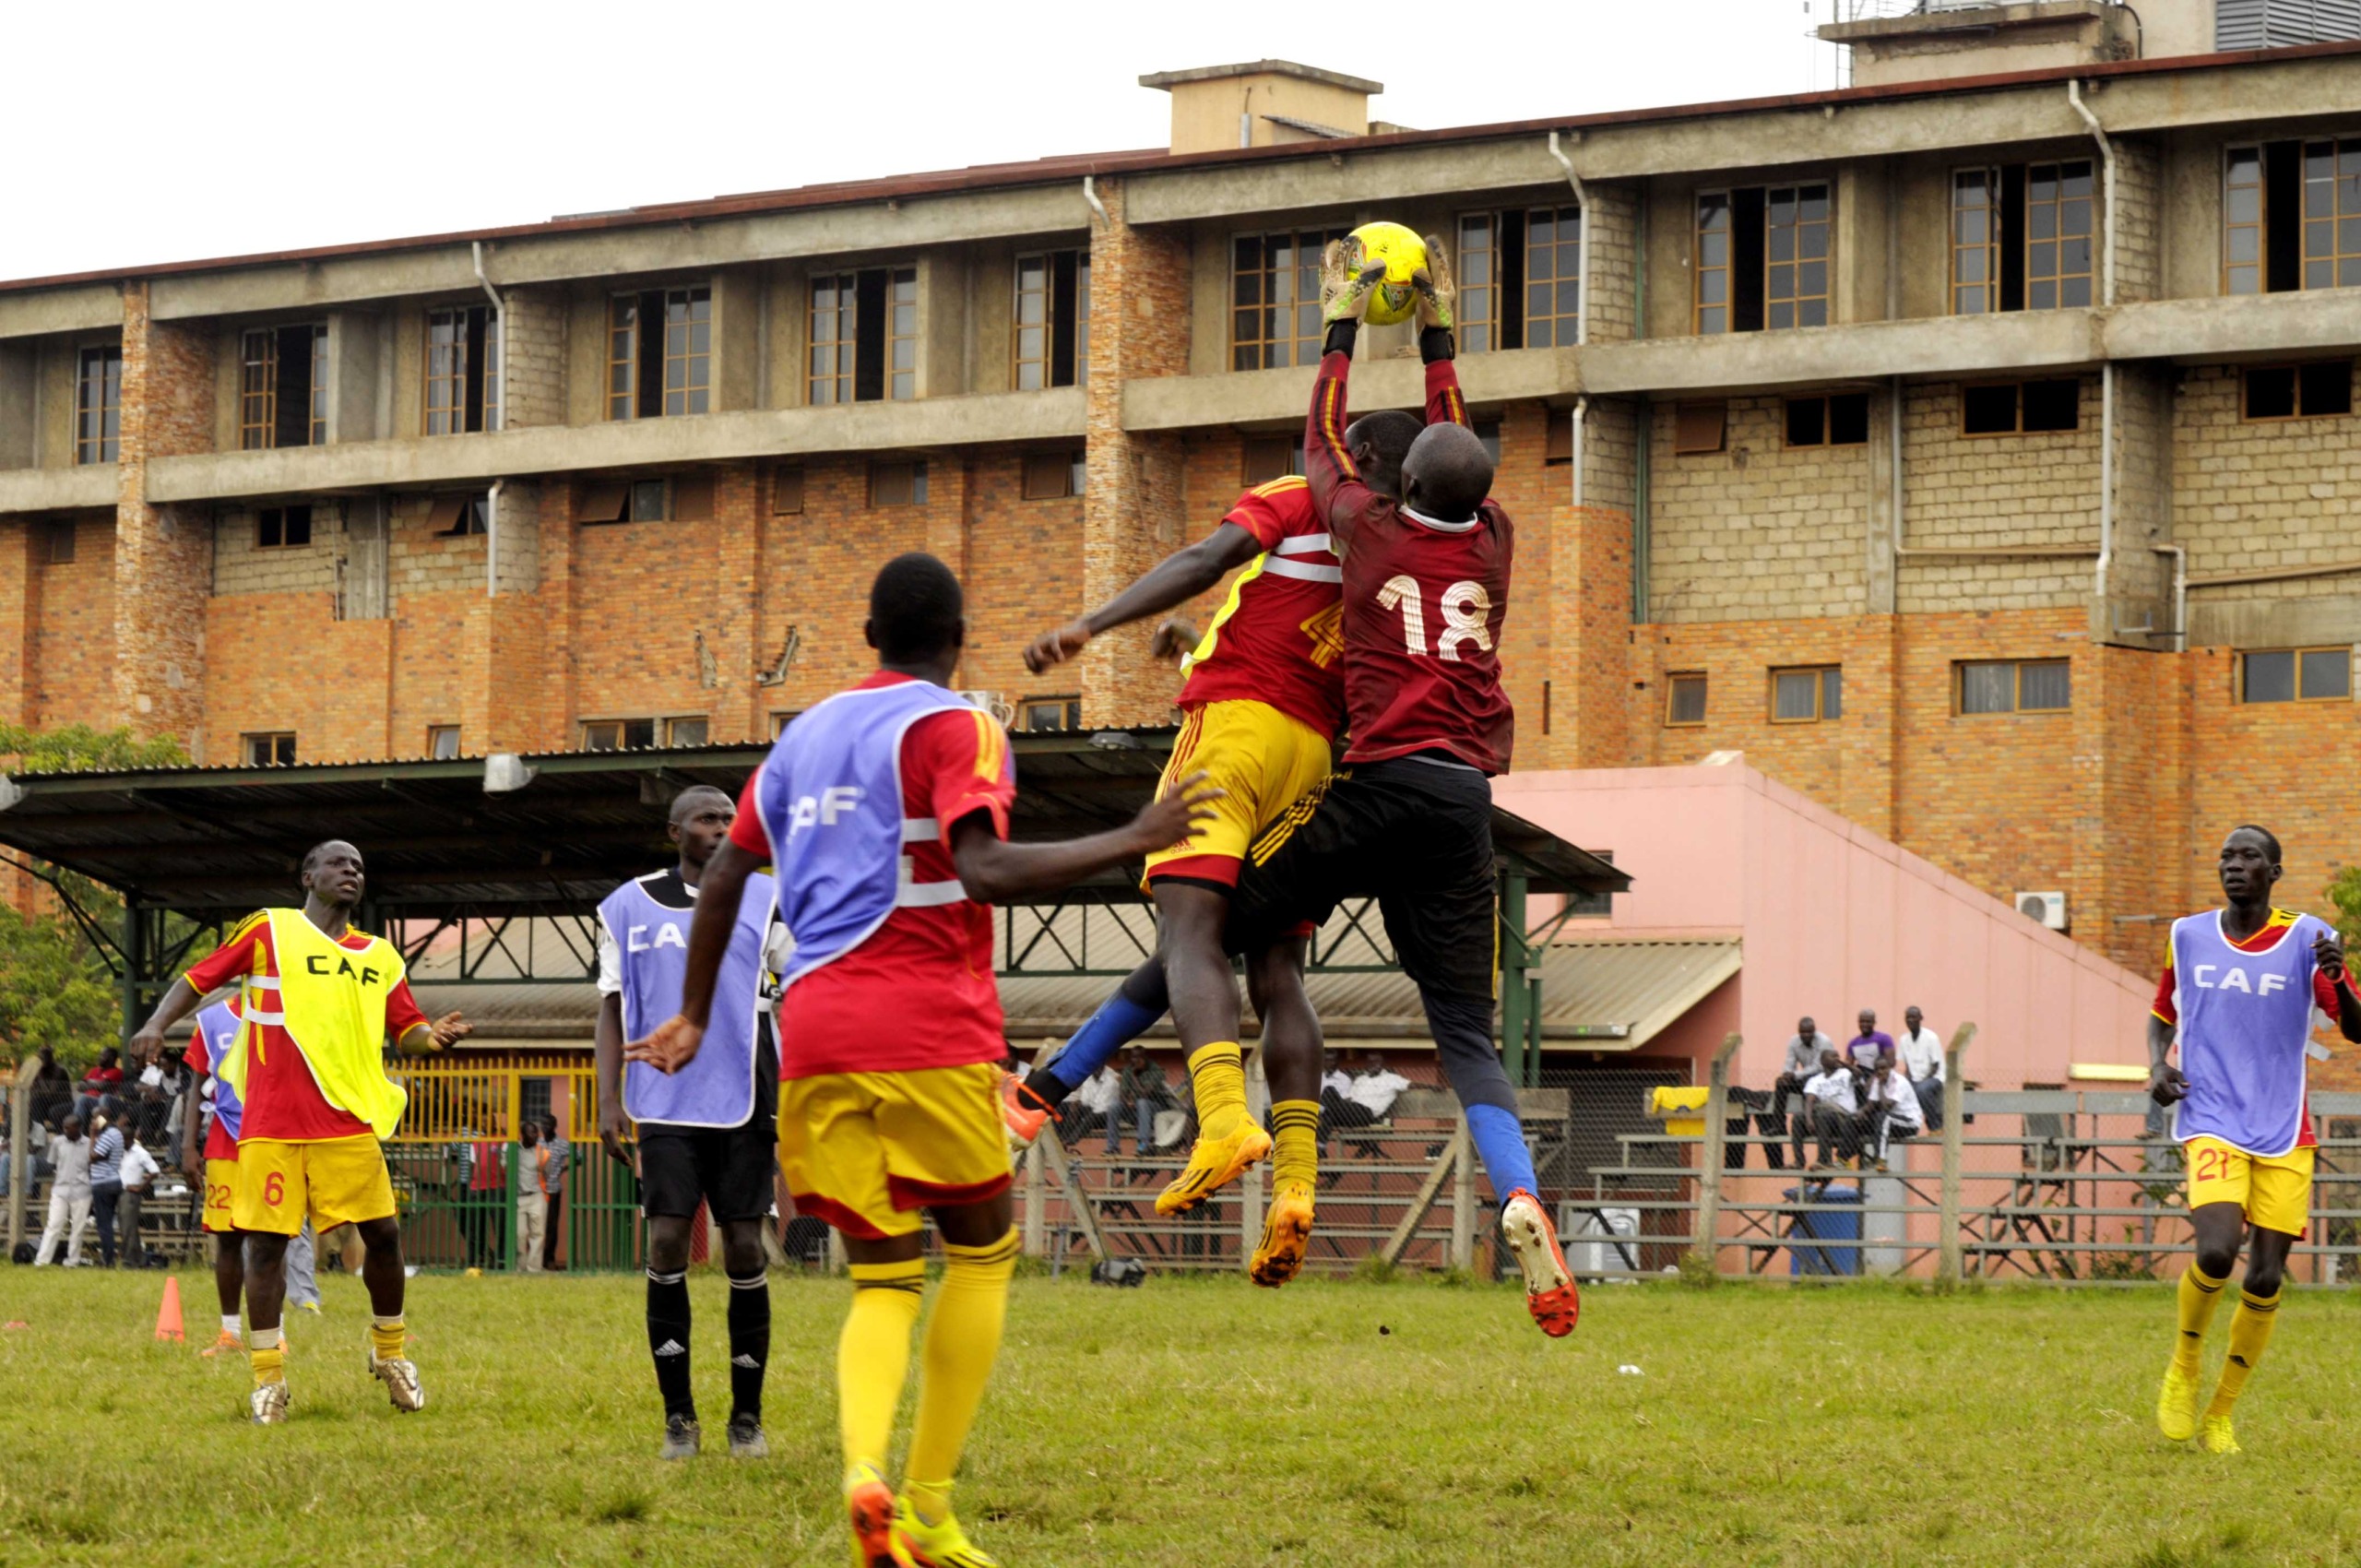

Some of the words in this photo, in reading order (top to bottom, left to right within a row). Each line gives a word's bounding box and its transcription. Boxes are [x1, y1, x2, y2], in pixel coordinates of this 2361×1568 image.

[1376, 575, 1492, 661] 18
[787, 786, 860, 837] AF
[627, 922, 687, 952] CA
[307, 956, 379, 987] CAF
[2194, 965, 2286, 996] CAF
[2197, 1148, 2232, 1182] 21
[208, 1184, 231, 1209] 22
[264, 1171, 285, 1206] 6
